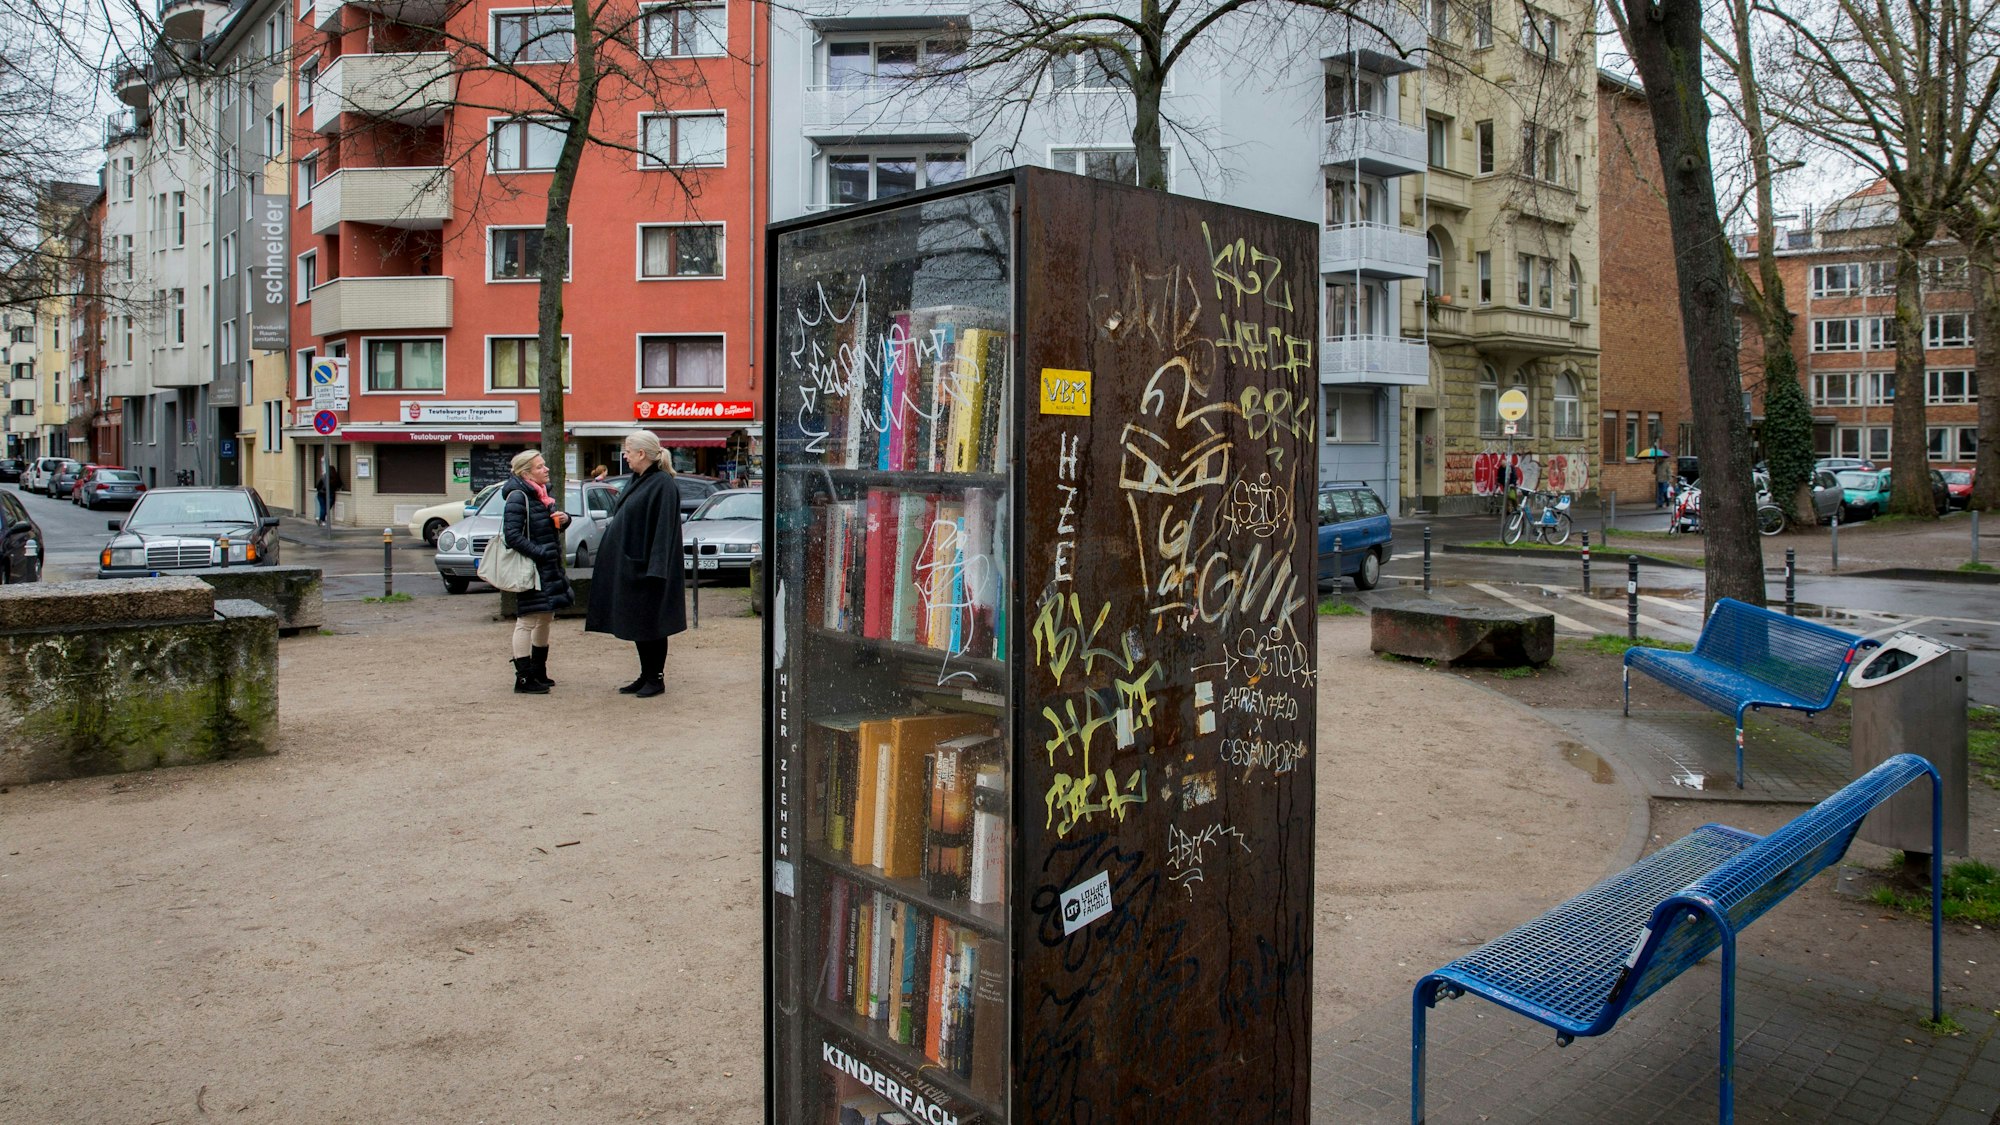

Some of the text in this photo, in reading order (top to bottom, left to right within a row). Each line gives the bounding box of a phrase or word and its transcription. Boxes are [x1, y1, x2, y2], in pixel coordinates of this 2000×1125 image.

[262, 200, 283, 304] schneider
[656, 402, 713, 417] Büdchen
[224, 443, 231, 451] P
[409, 433, 495, 442] Teutoburger Treppchen
[780, 673, 788, 857] HIER ZIEHEN
[1082, 890, 1104, 908] THAN
[1083, 895, 1109, 917] FAMOUS
[823, 1041, 958, 1125] KINDERFACH
